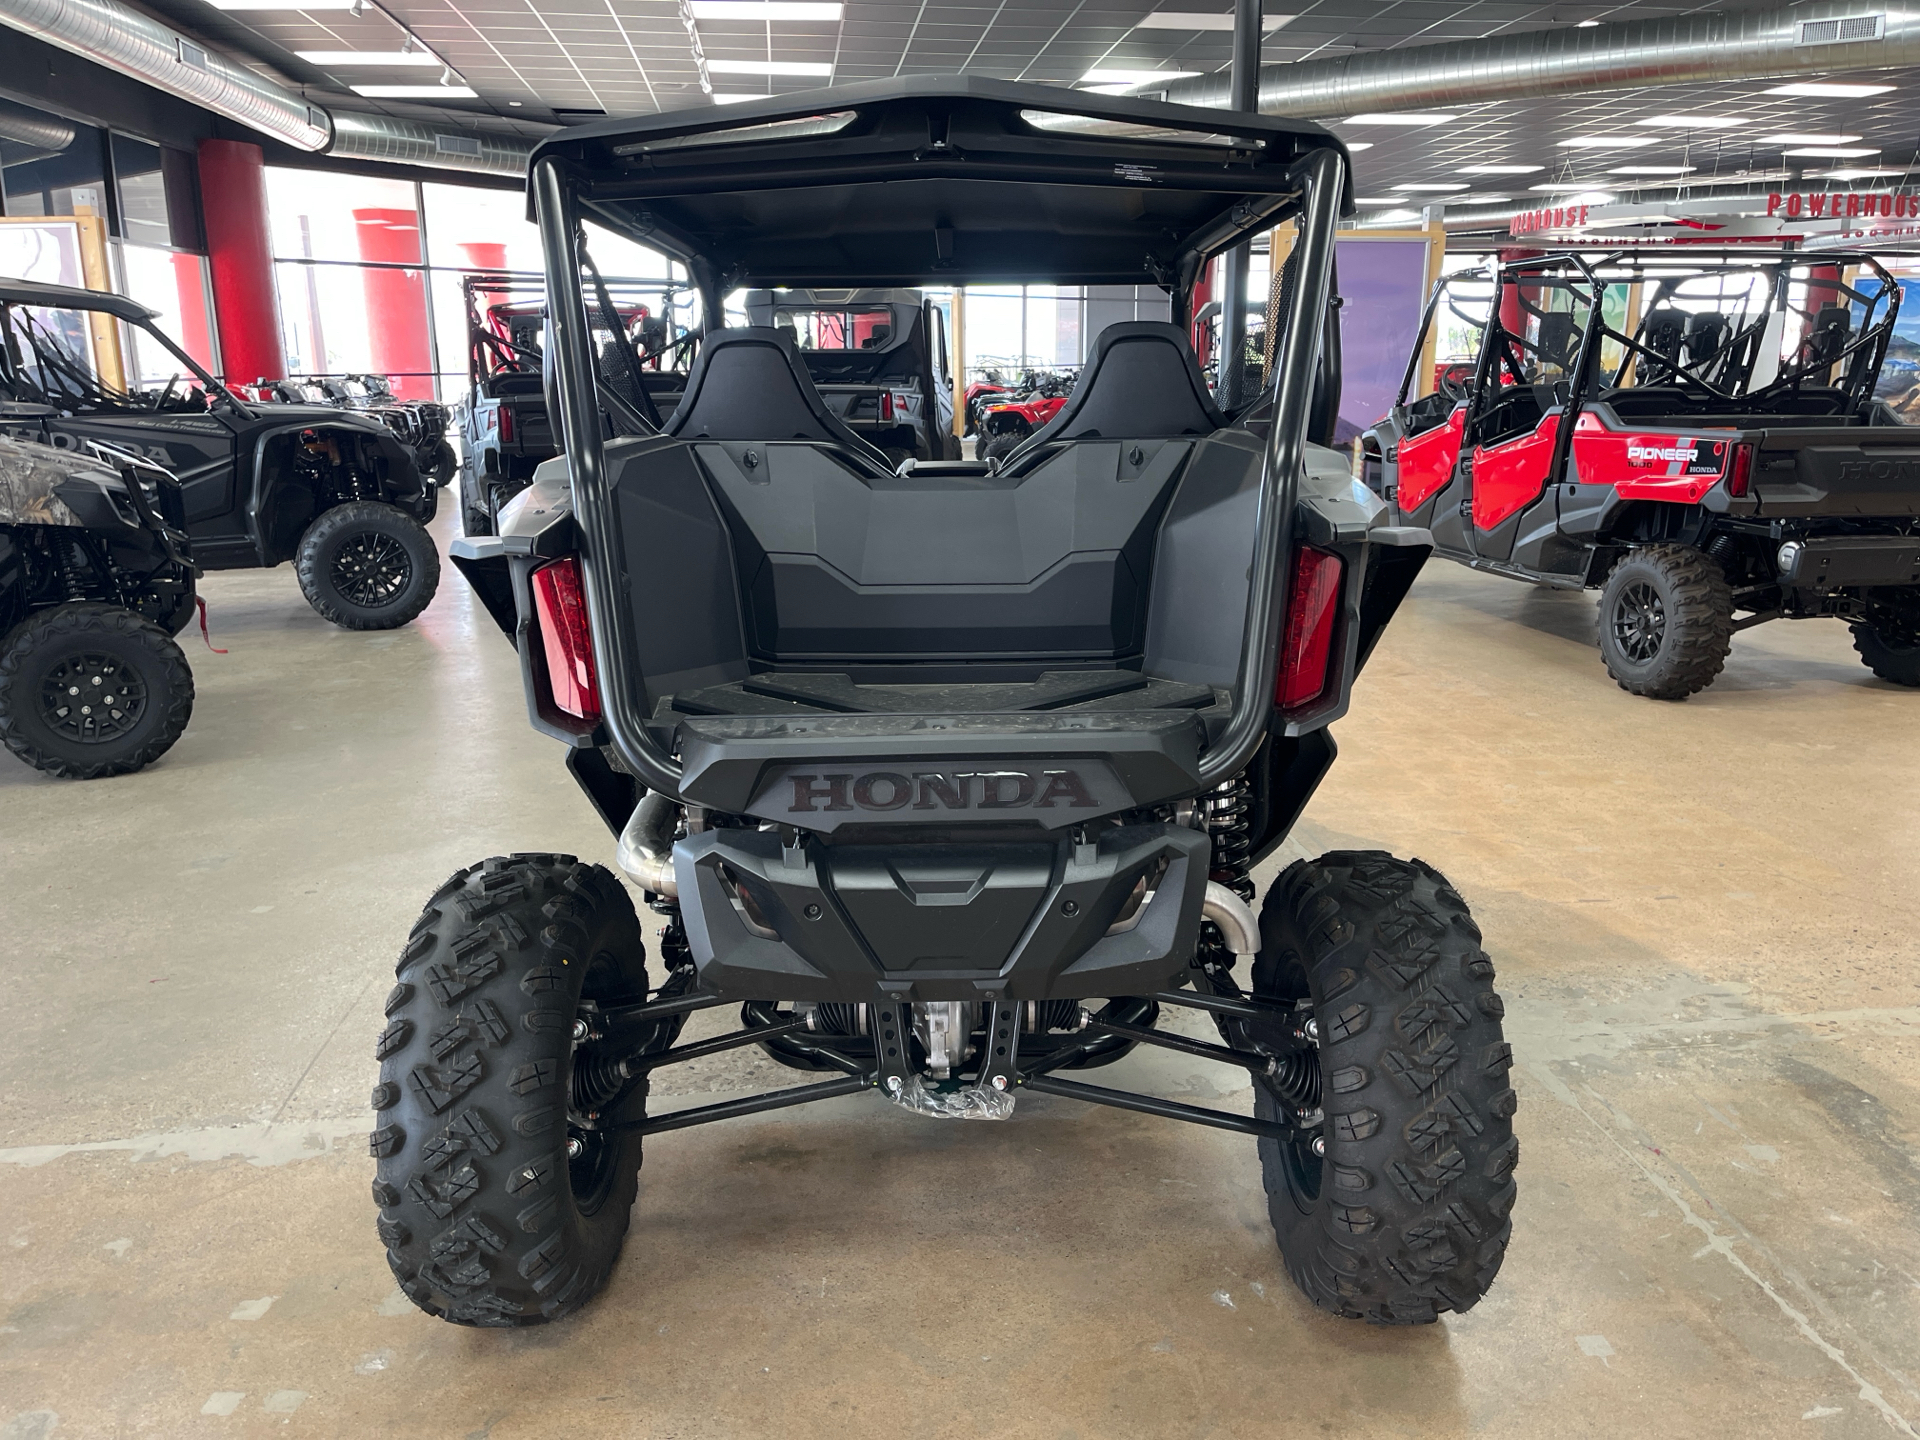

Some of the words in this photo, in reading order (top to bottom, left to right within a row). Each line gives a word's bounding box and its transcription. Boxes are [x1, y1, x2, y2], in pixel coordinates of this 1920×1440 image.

[1628, 447, 1698, 462] PIONEER
[1689, 466, 1718, 474] HONDA
[787, 770, 1099, 812] HONDA
